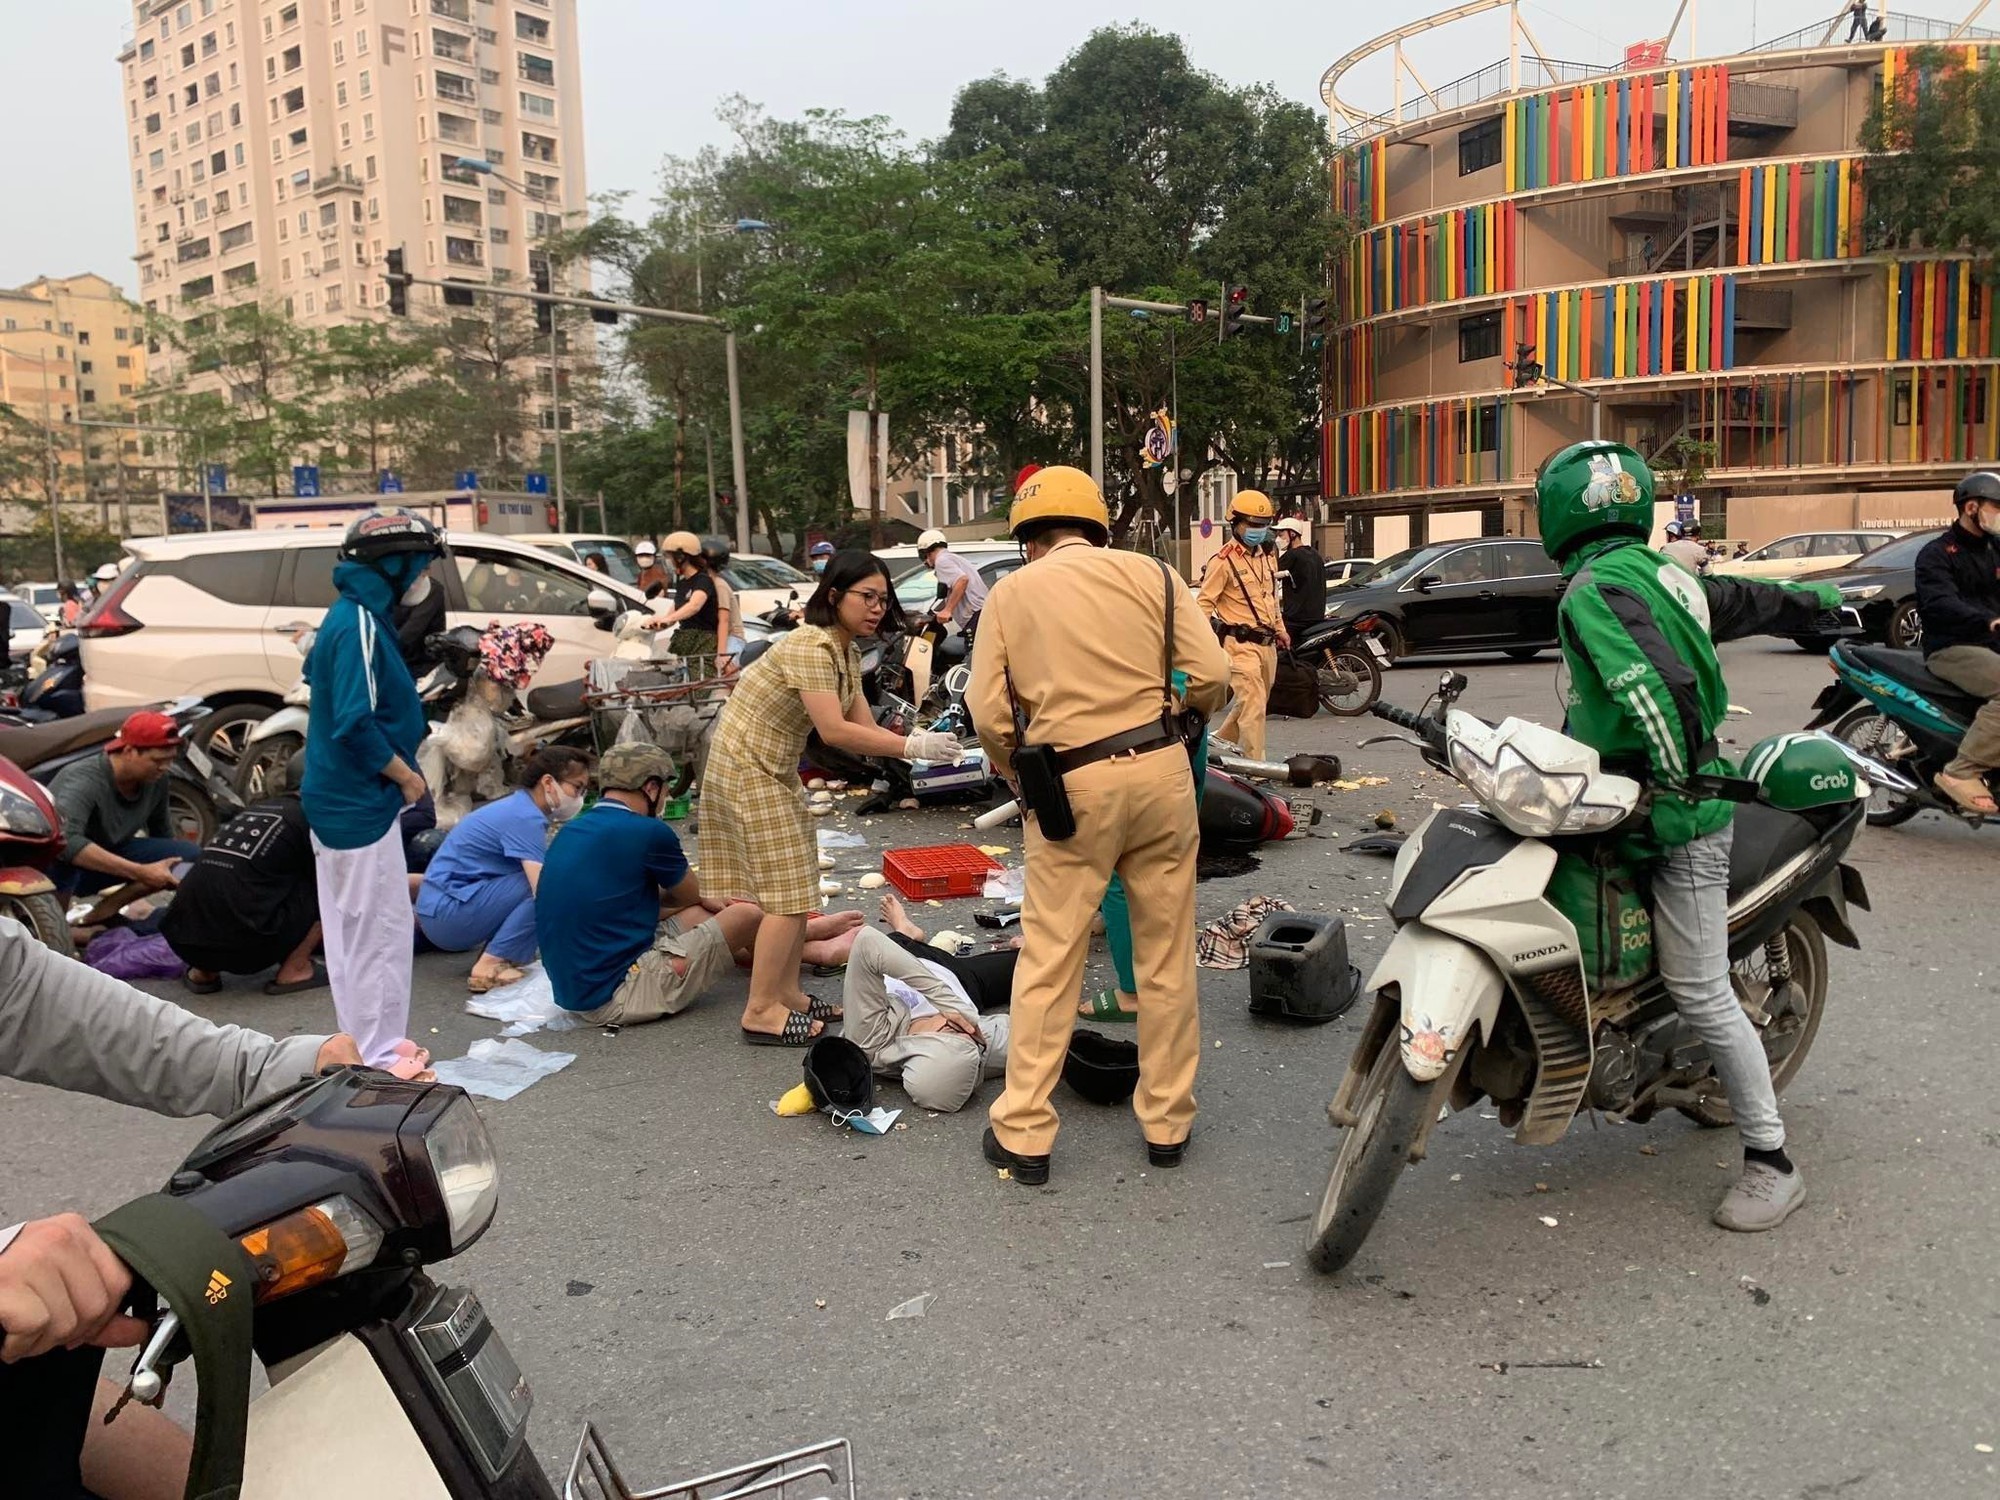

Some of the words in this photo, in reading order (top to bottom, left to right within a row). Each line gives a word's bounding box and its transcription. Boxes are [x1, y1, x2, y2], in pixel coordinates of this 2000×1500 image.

[381, 24, 405, 66] F
[1606, 663, 1647, 690] Grab
[1810, 770, 1848, 790] Grab
[1297, 803, 1312, 833] 0143
[1620, 907, 1650, 929] Gra
[1513, 943, 1568, 962] HONDA
